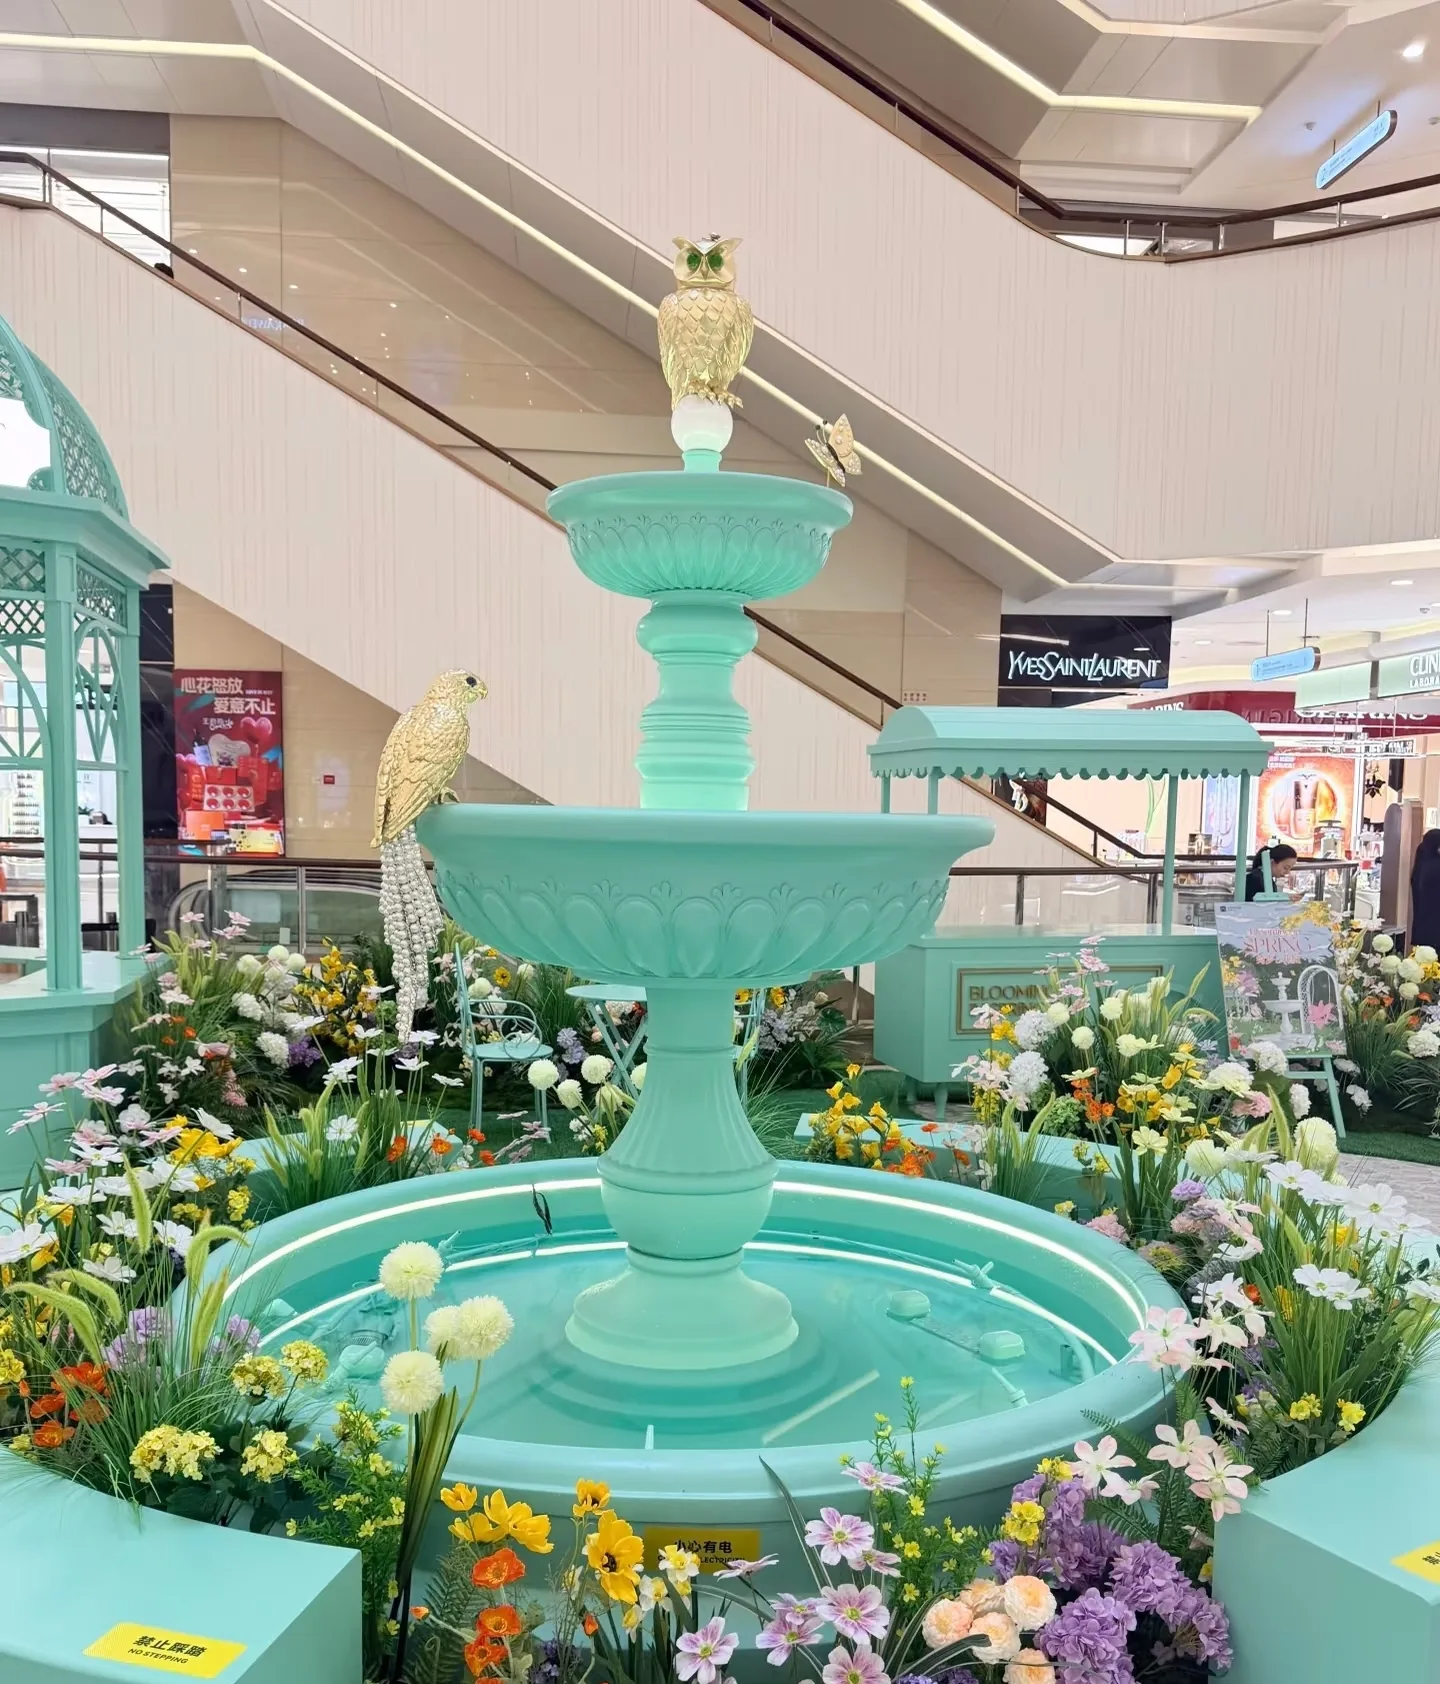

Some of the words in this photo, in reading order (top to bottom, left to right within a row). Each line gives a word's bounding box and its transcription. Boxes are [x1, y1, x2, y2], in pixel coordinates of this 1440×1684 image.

[213, 697, 277, 715] 爱意不止
[1243, 937, 1313, 954] SPRING
[969, 985, 1050, 1001] BLOOMIN
[133, 1635, 208, 1658] 禁止踩踏
[127, 1648, 143, 1656] NO
[143, 1651, 189, 1664] STEPPING
